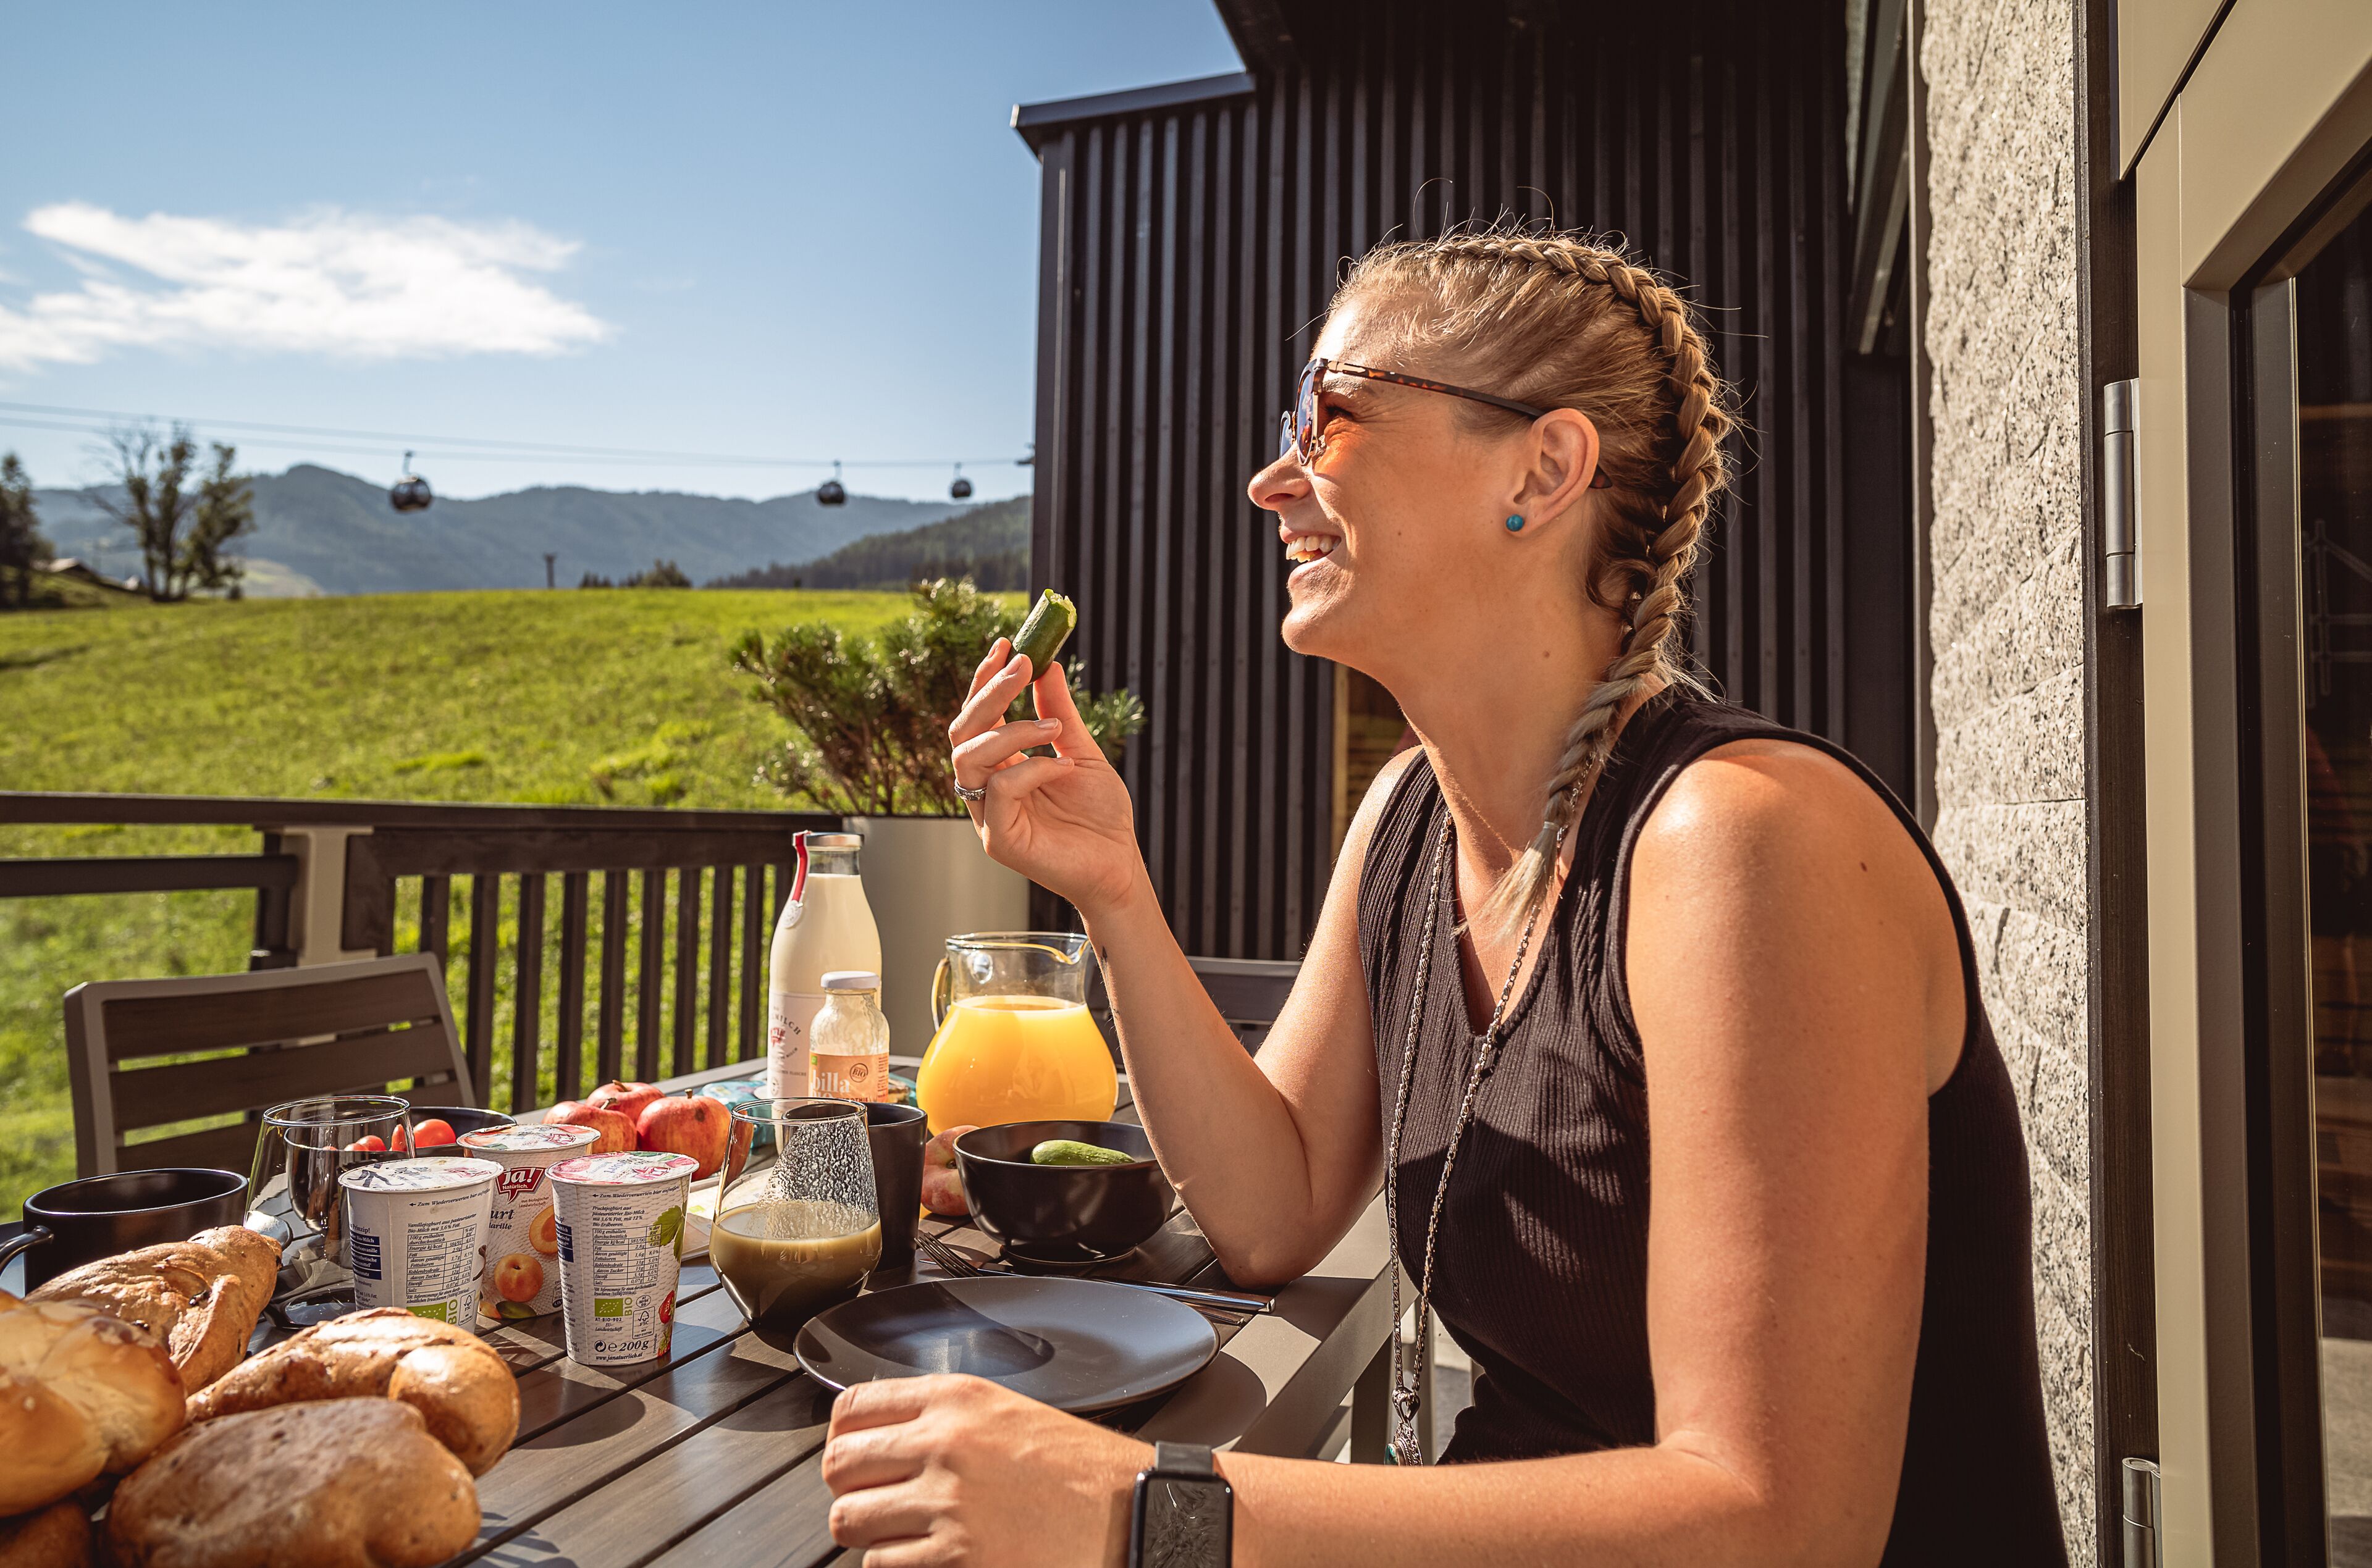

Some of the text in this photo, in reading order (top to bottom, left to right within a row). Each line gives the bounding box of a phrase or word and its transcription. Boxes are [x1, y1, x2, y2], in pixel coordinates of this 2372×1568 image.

[852, 1068, 866, 1078] BIO
[812, 1070, 851, 1093] billa
[502, 1167, 536, 1185] ja!
[432, 1196, 469, 1205] Wiederverwerten
[450, 1213, 477, 1224] pasteurisierter
[490, 1209, 515, 1220] urt
[448, 1299, 458, 1324] BIO
[625, 1297, 633, 1316] BIO
[596, 1352, 643, 1362] www.janatuerlich.at
